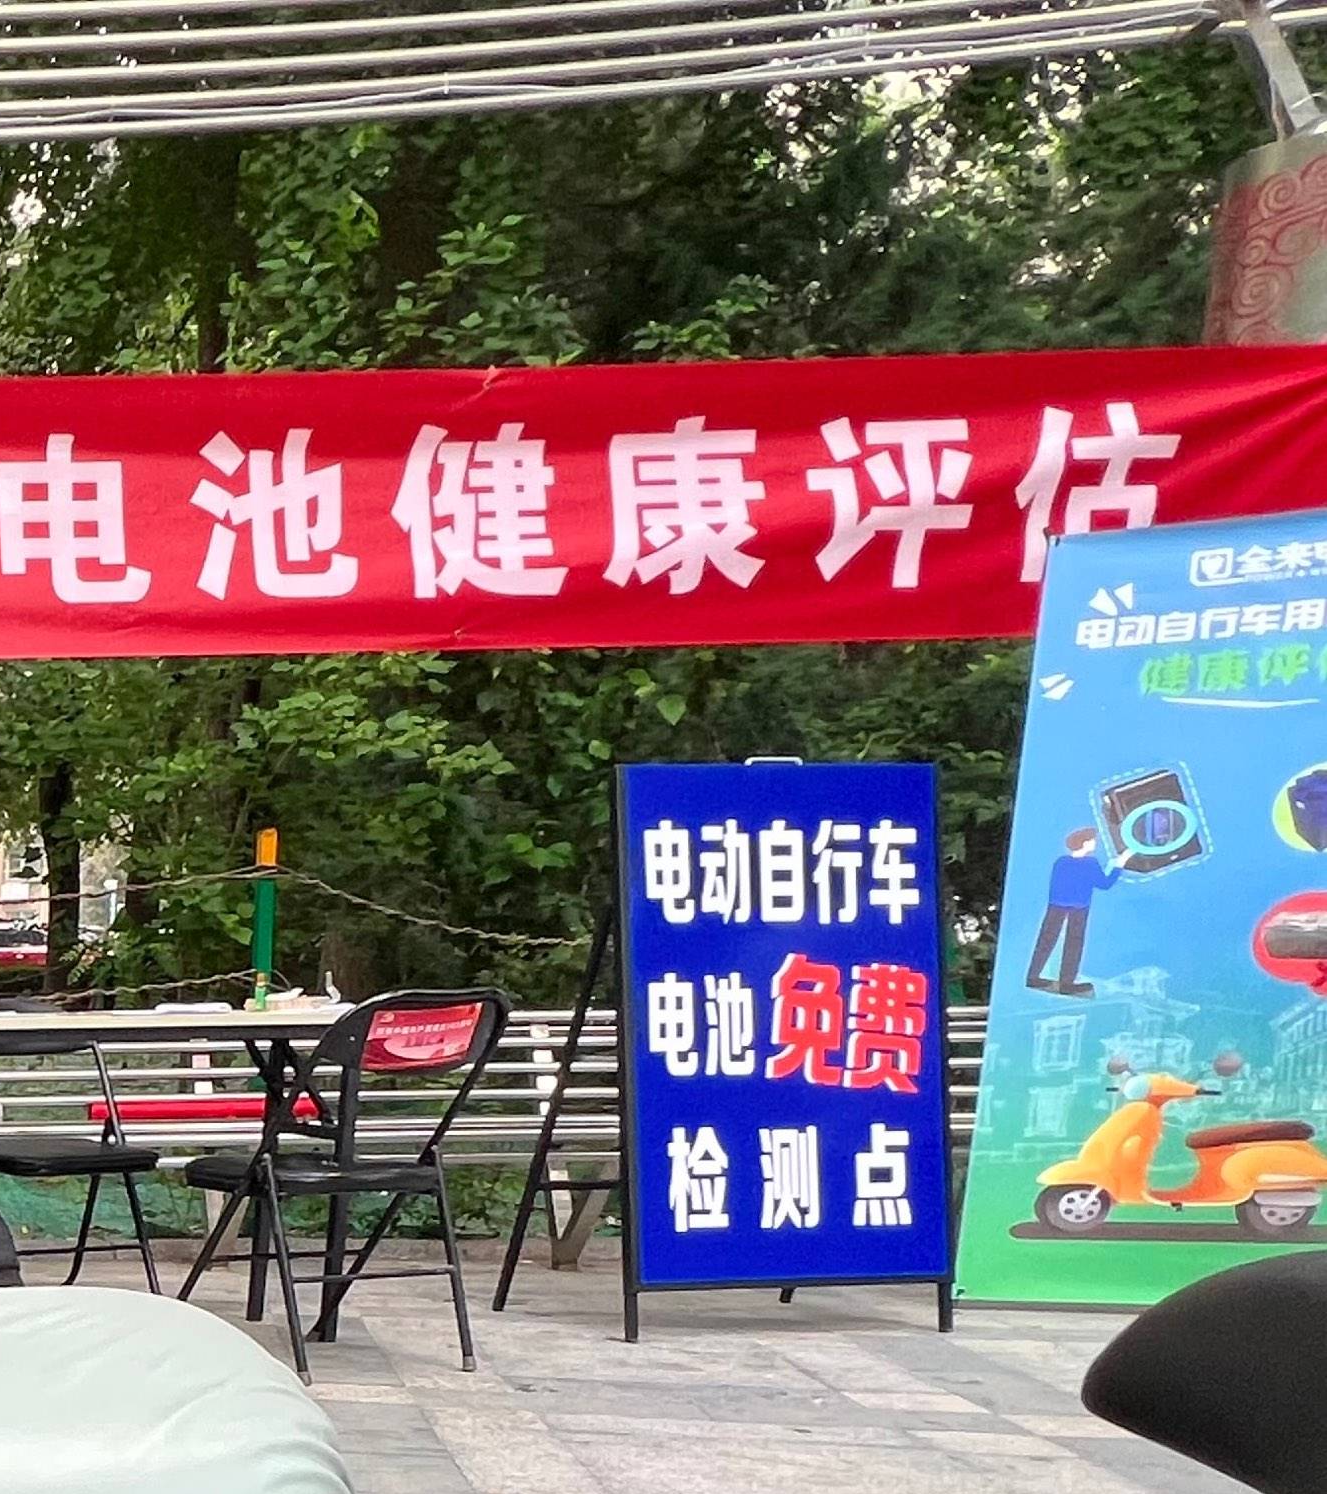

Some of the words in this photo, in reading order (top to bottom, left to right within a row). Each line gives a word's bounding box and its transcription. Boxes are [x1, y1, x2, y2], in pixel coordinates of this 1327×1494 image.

[1076, 598, 1327, 650] 电动自行车用
[1140, 643, 1327, 696] 健康评
[643, 818, 921, 927] 电动自行车
